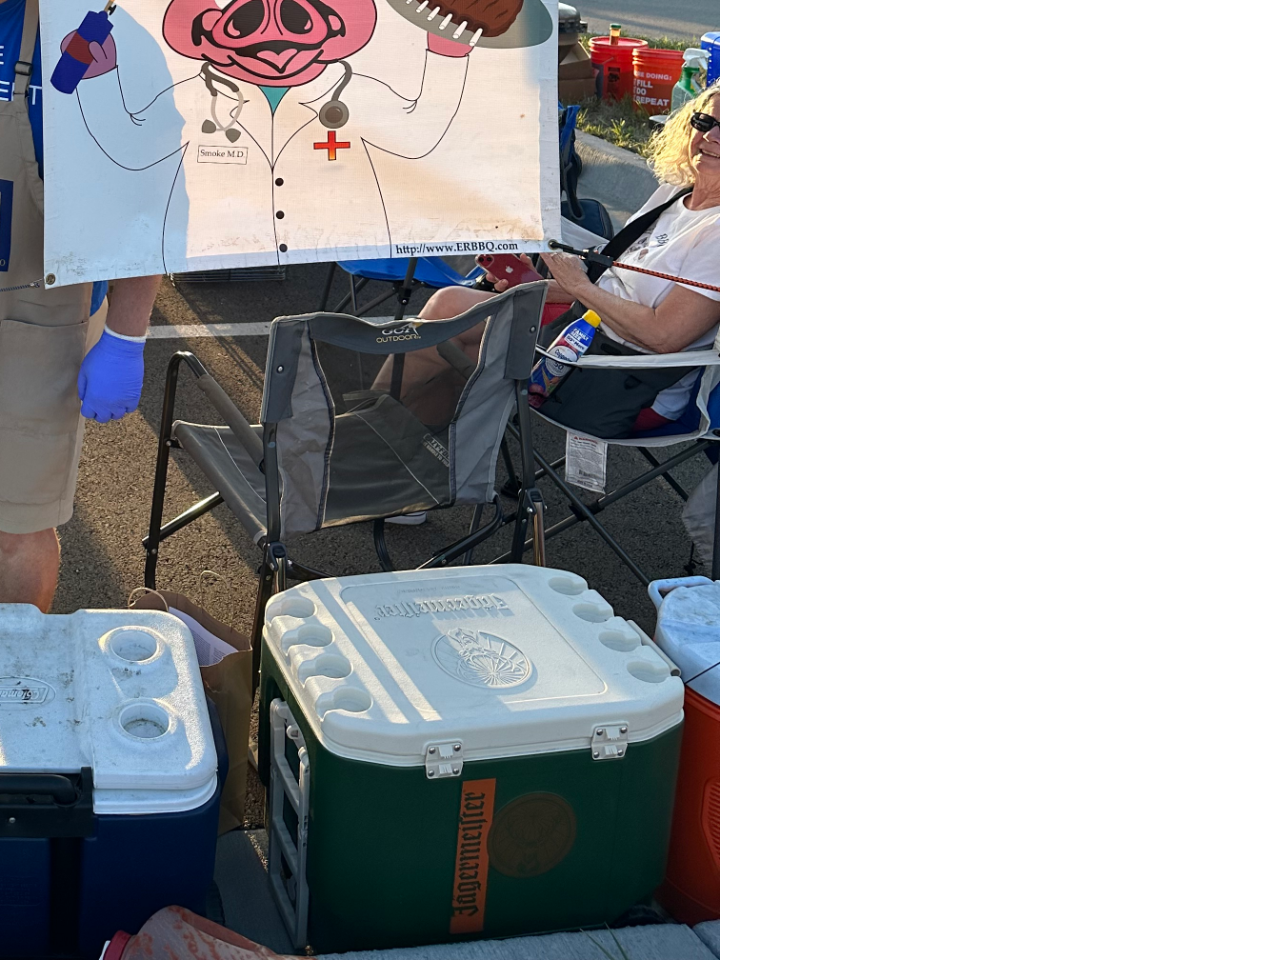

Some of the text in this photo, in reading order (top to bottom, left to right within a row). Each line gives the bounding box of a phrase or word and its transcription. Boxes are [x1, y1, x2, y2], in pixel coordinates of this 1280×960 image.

[636, 79, 653, 88] FILL
[636, 95, 669, 107] REPEAT
[200, 149, 225, 157] Smoke
[396, 241, 518, 256] http://www.ERBBQ.com
